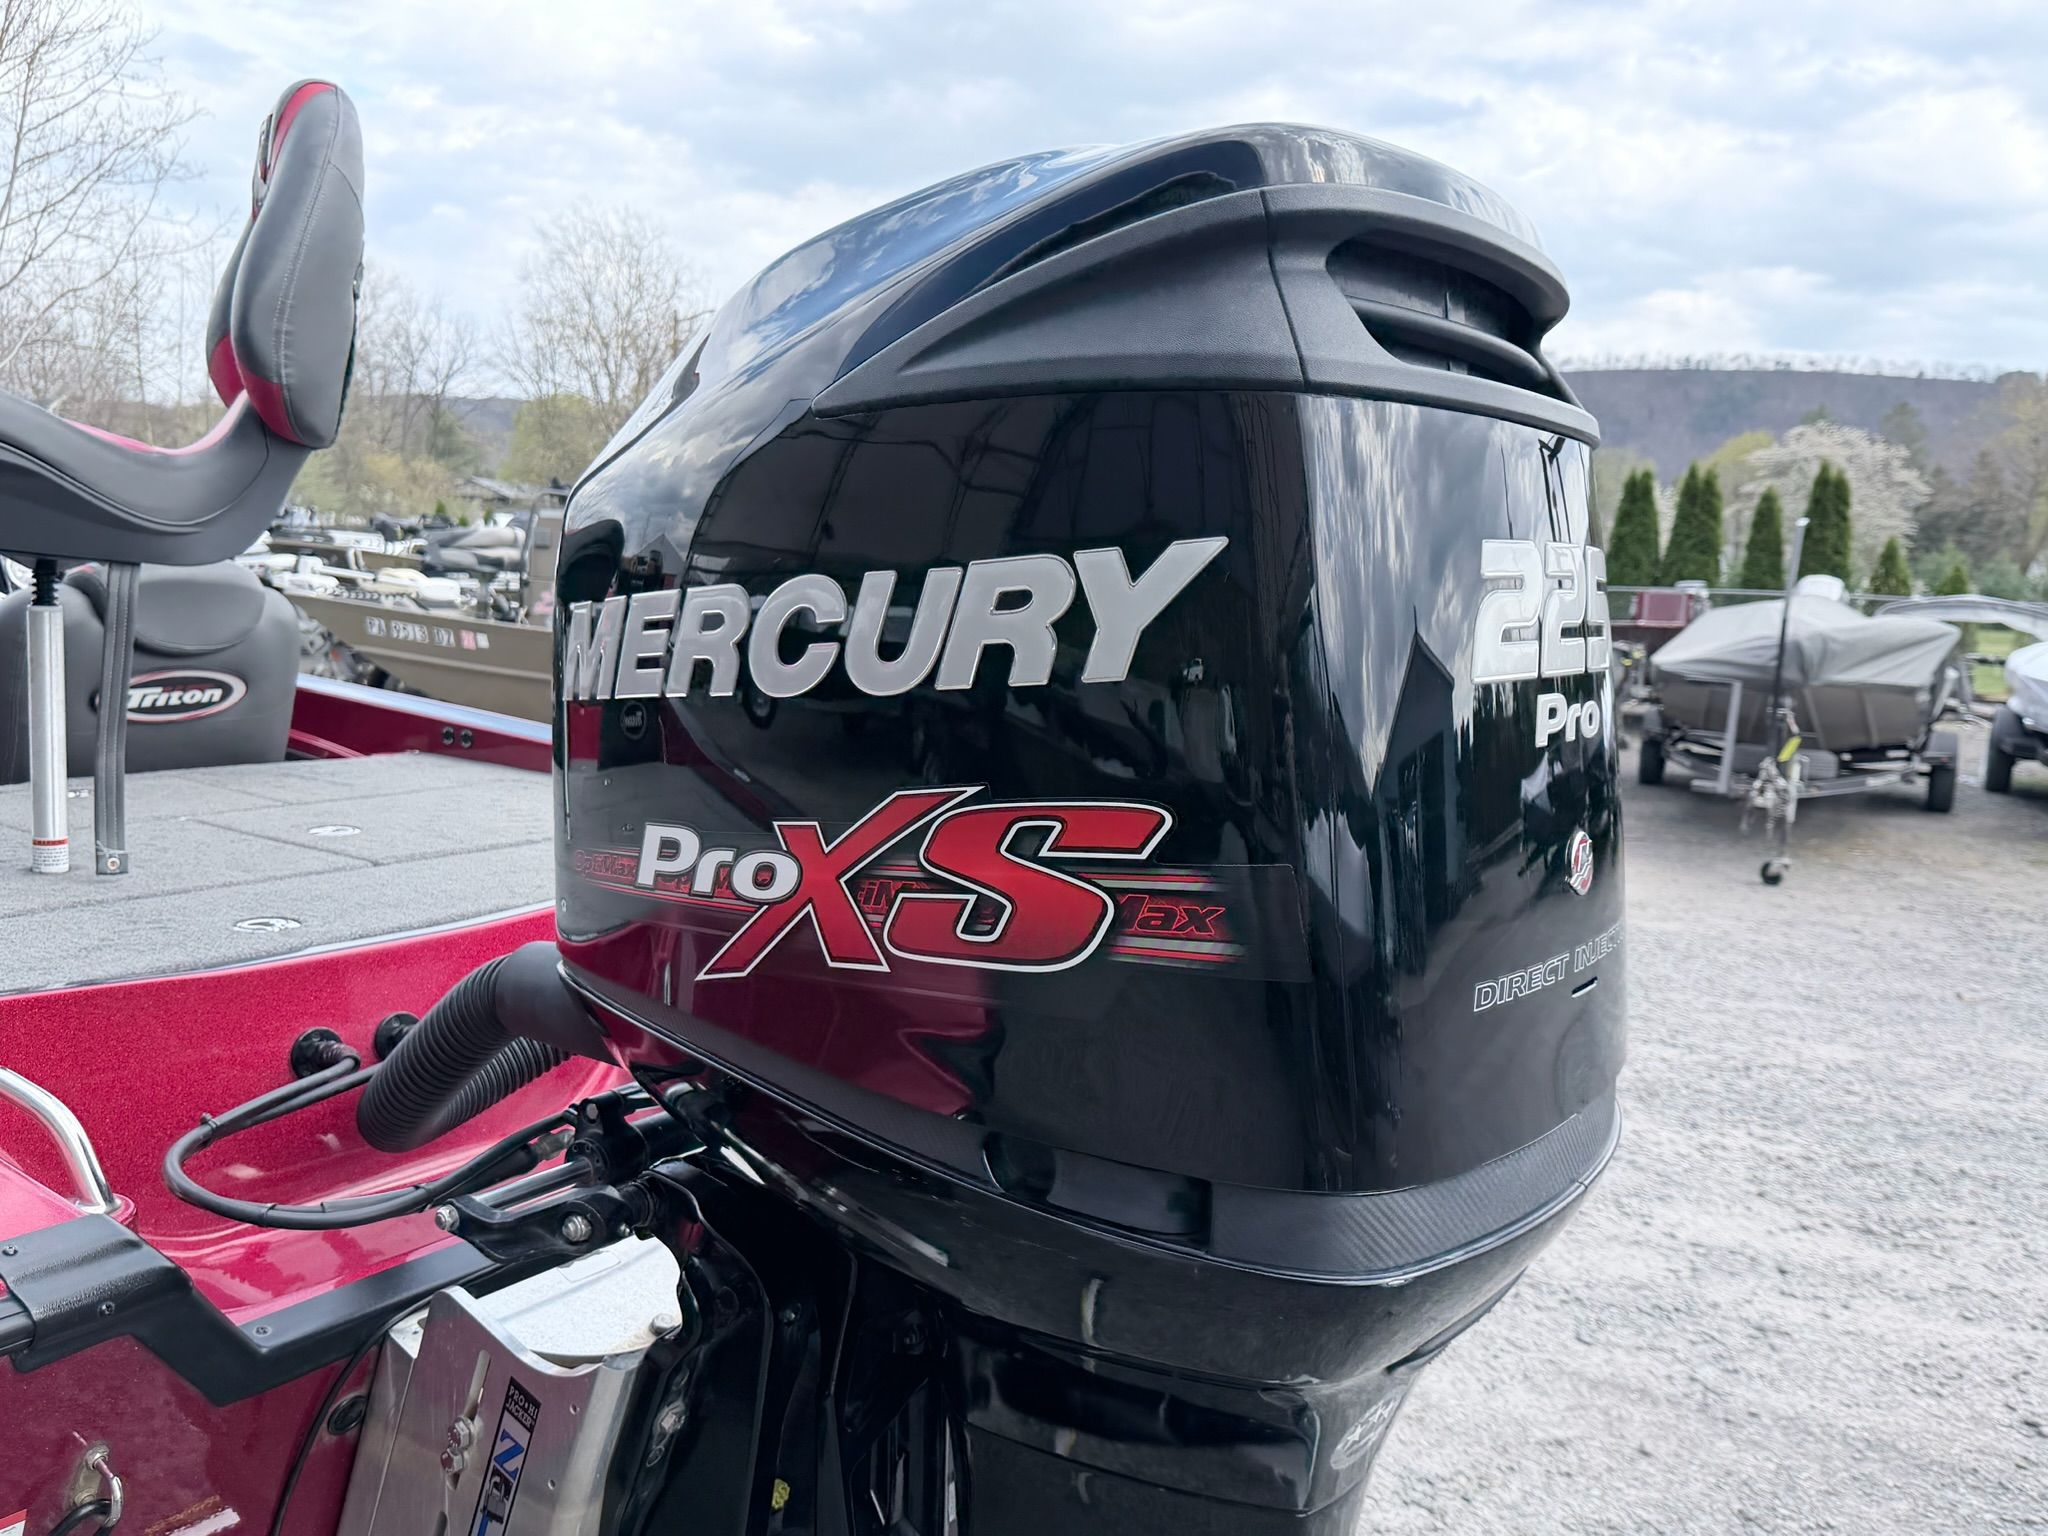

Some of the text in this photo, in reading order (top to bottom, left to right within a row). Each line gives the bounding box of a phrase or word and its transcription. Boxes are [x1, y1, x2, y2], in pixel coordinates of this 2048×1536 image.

[562, 536, 1229, 702] MERCURY
[1471, 539, 1609, 684] 225
[127, 686, 224, 709] Triton
[1535, 692, 1601, 748] Pro
[1474, 953, 1570, 1012] DIRECT
